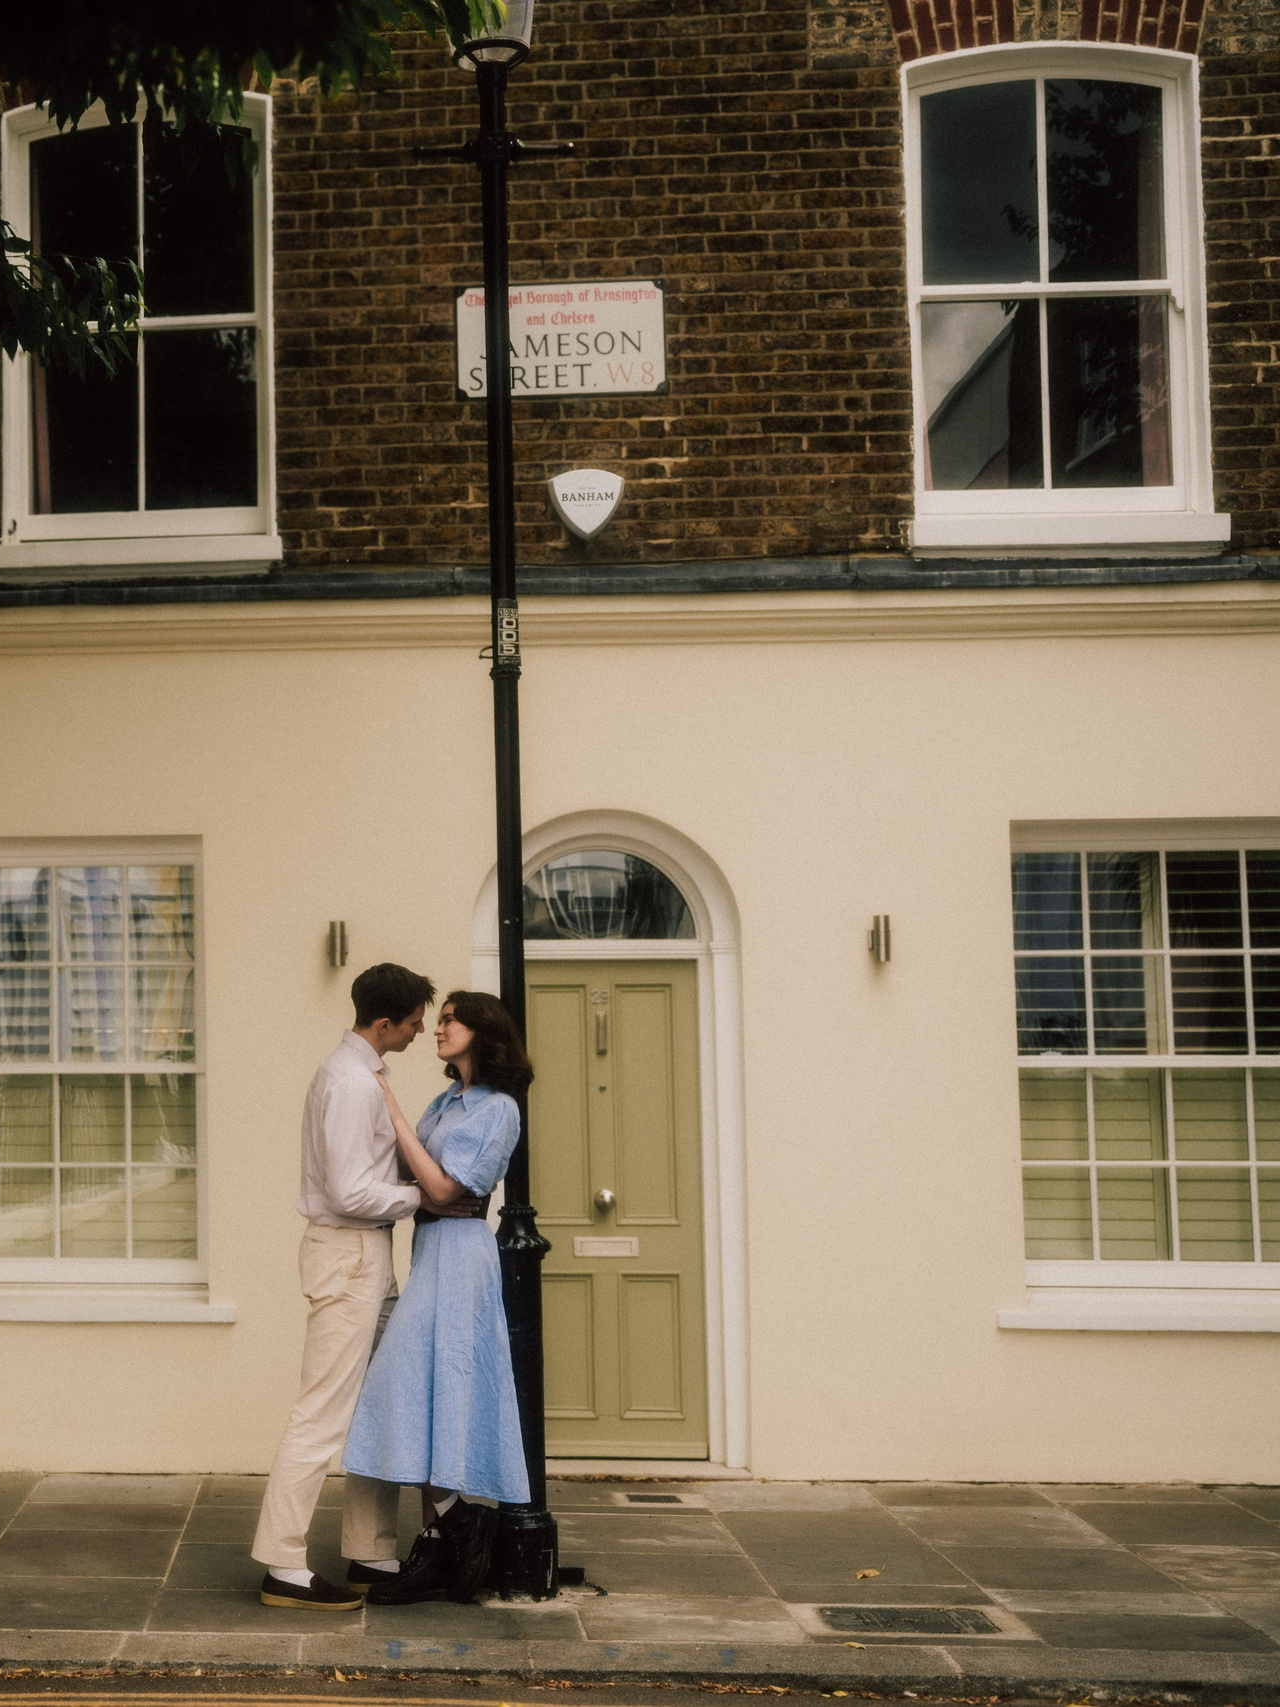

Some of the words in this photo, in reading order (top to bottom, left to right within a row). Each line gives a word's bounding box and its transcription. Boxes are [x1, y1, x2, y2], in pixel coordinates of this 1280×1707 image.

[526, 291, 573, 306] Borough
[578, 289, 590, 302] of
[594, 288, 657, 304] Kensington
[526, 313, 546, 325] and
[551, 311, 595, 325] Chelsea
[480, 331, 642, 359] MESON
[561, 492, 614, 502] BANHAM
